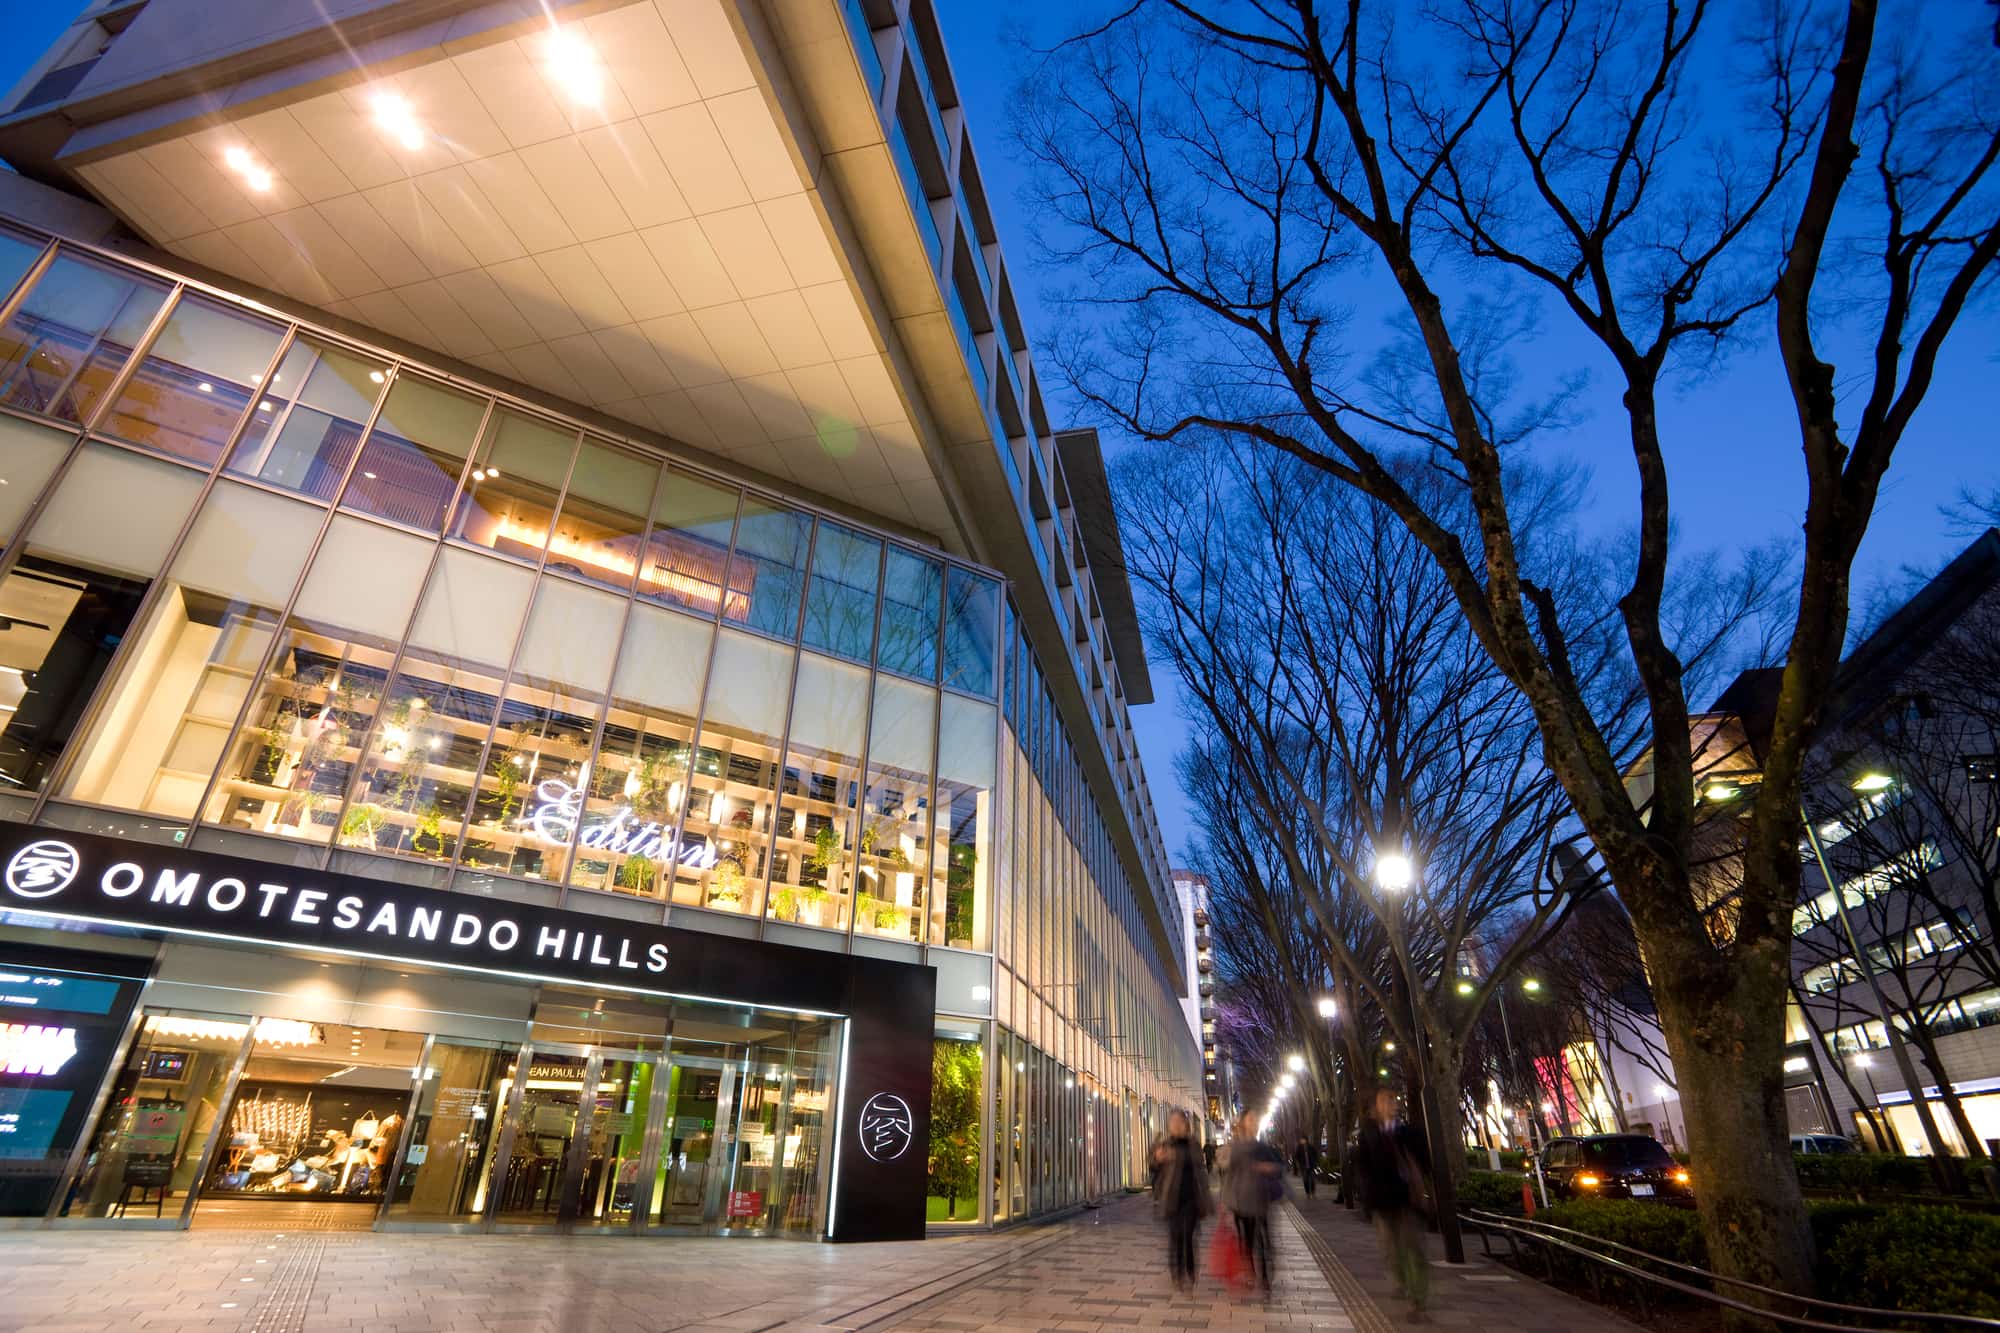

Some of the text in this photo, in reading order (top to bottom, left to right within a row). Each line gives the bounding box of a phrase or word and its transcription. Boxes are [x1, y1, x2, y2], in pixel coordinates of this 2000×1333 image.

[514, 779, 719, 869] Edition
[100, 861, 669, 973] OMOTESANDO HILLS
[528, 1066, 550, 1078] EAN
[550, 1067, 575, 1079] PAUL
